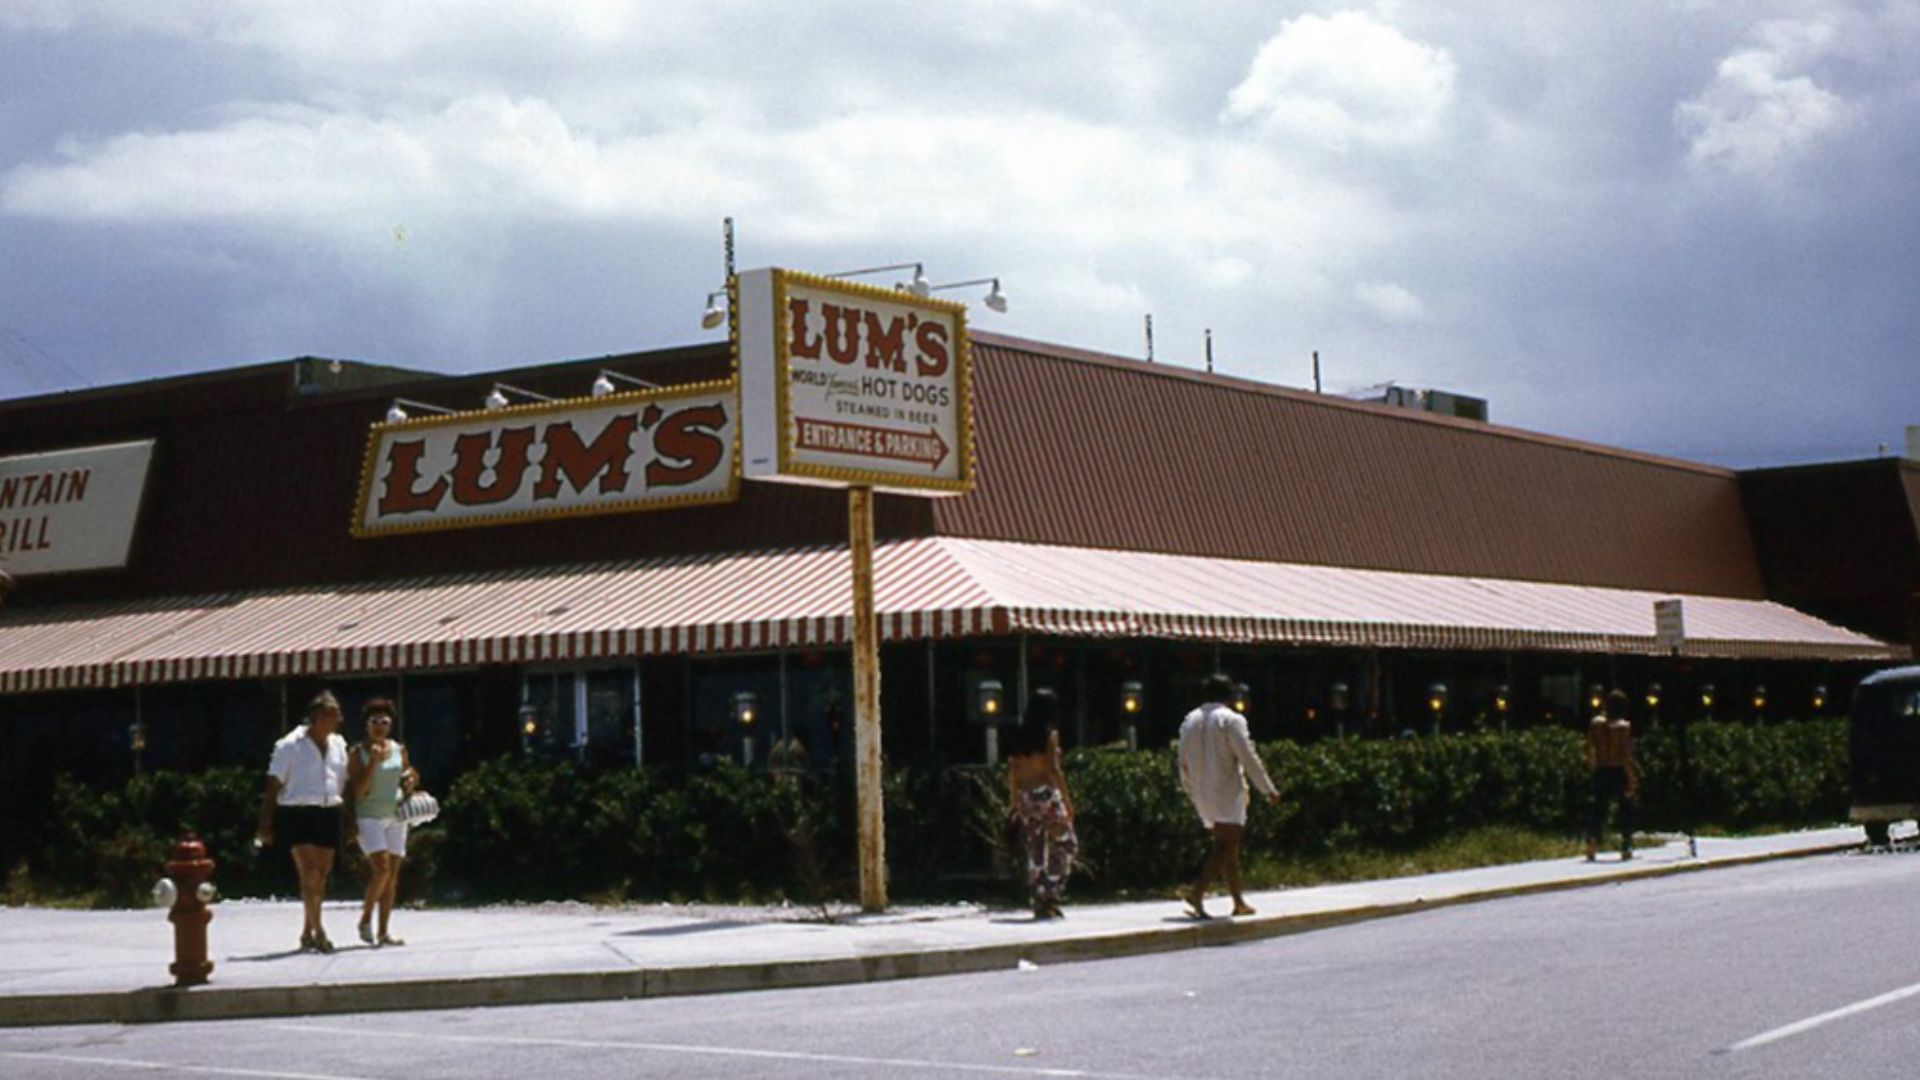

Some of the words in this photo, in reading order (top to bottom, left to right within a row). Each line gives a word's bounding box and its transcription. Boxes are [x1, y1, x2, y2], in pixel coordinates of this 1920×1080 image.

[789, 297, 949, 377] LUM'S
[792, 369, 827, 386] WORLD
[861, 376, 897, 398] HOT
[902, 381, 949, 407] DOGS
[836, 400, 890, 419] STEAMED
[894, 407, 905, 420] IN
[908, 410, 939, 425] BEER
[803, 422, 872, 453] ENTRANCE
[378, 401, 728, 518] LUM'S
[0, 469, 91, 509] NTAIN
